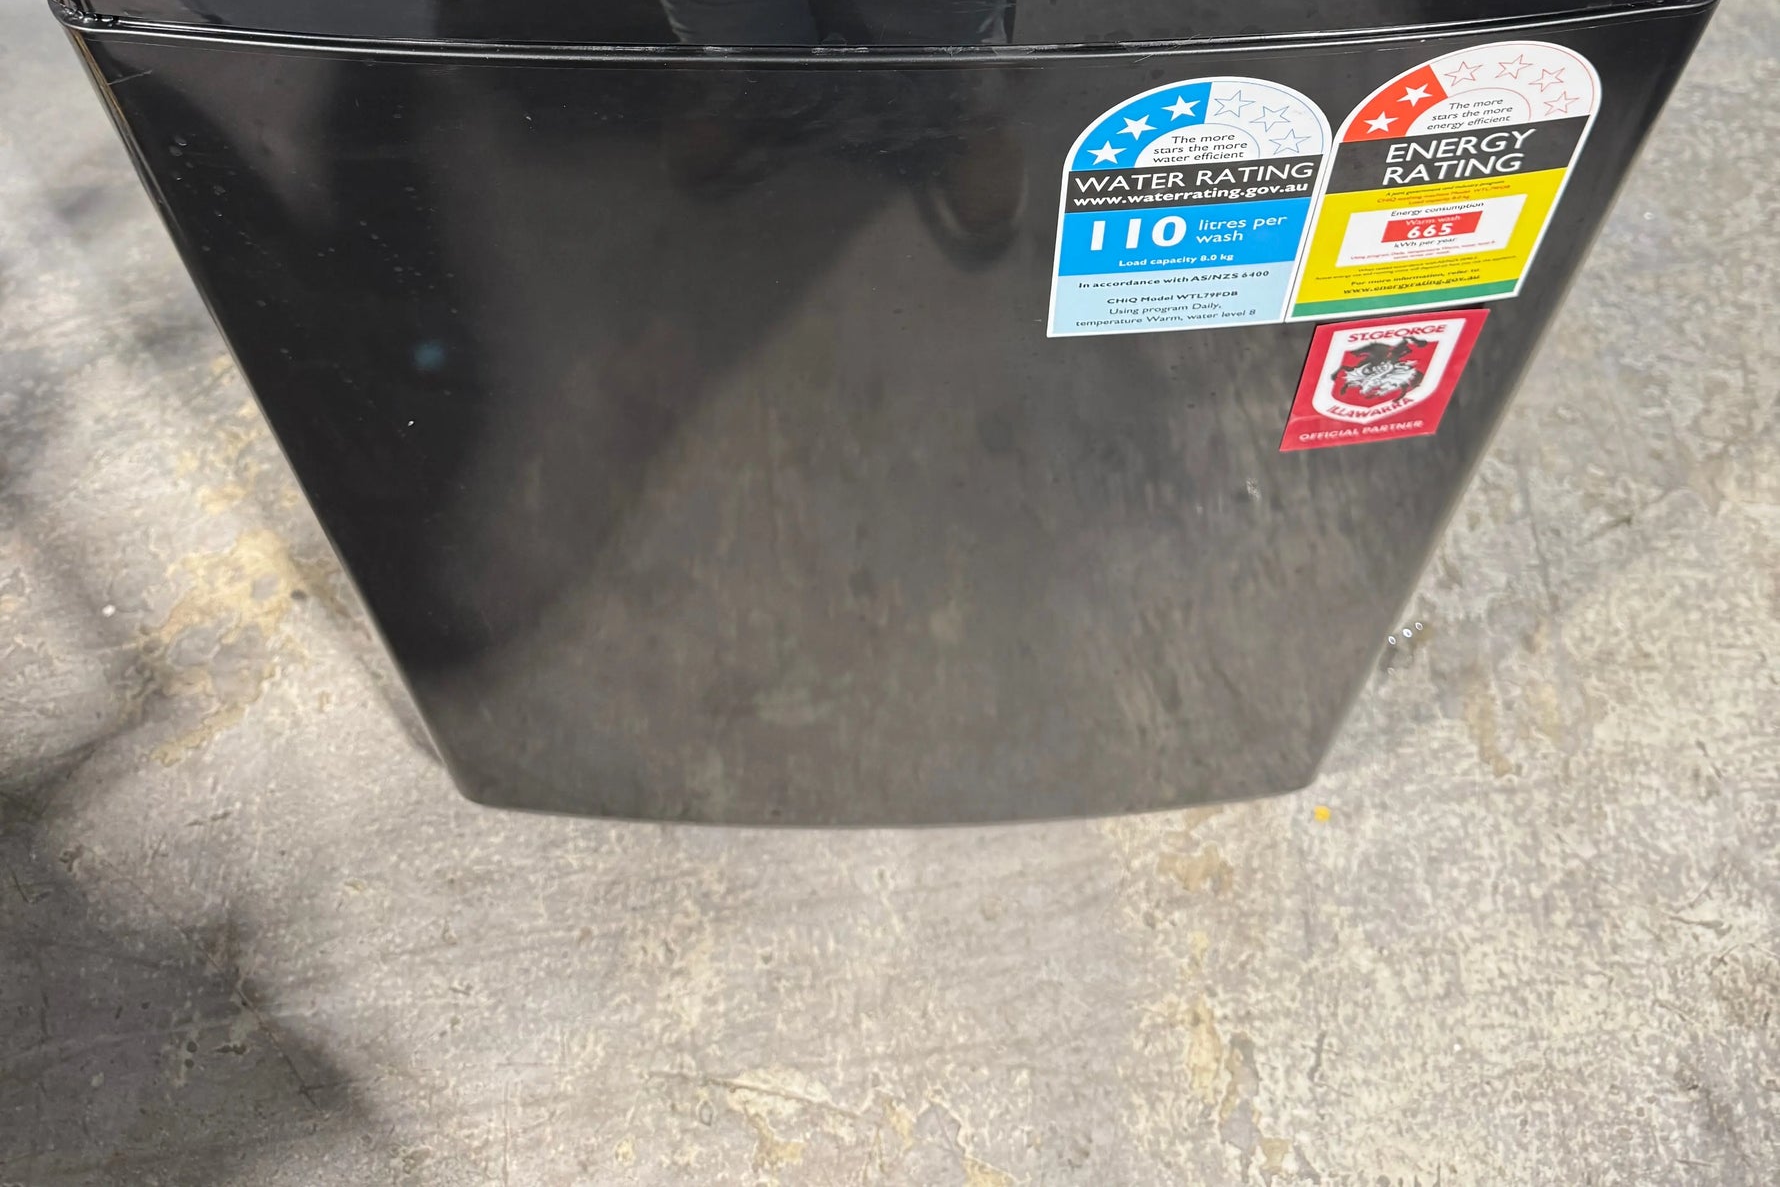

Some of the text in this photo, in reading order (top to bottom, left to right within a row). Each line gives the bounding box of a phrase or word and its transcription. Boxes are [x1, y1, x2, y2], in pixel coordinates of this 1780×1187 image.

[1448, 99, 1504, 110] The more
[1431, 107, 1513, 122] stars the more
[1427, 116, 1511, 131] energy efficient
[1172, 133, 1236, 144] The more
[1385, 128, 1537, 164] ENERGY
[1153, 142, 1248, 155] stars the more
[1153, 151, 1244, 164] water efficient
[1382, 153, 1525, 186] RATING
[1075, 162, 1315, 193] WATER RATING
[1073, 182, 1309, 207] www.waterrating.gov.au
[1424, 202, 1485, 214] consumption
[1199, 216, 1288, 232] litres per
[1438, 215, 1461, 223] wash
[1090, 215, 1187, 251] 110
[1196, 231, 1244, 244] wash
[1406, 223, 1454, 239] 665
[1394, 241, 1418, 249] kWh
[1436, 238, 1457, 246] year
[1119, 253, 1234, 267] Load capacity 8.0 kg
[1092, 278, 1161, 289] accordance
[1163, 276, 1189, 284] with
[1191, 272, 1239, 282] AS/NZS
[1242, 270, 1270, 278] 6400
[1140, 295, 1174, 303] Model
[1109, 307, 1140, 315] Using
[1142, 305, 1189, 314] program
[1076, 318, 1143, 328] temperature
[1187, 312, 1219, 320] water
[1326, 397, 1415, 418] ILLAWARRA
[1299, 420, 1425, 442] OFFICIAL PARTNER
